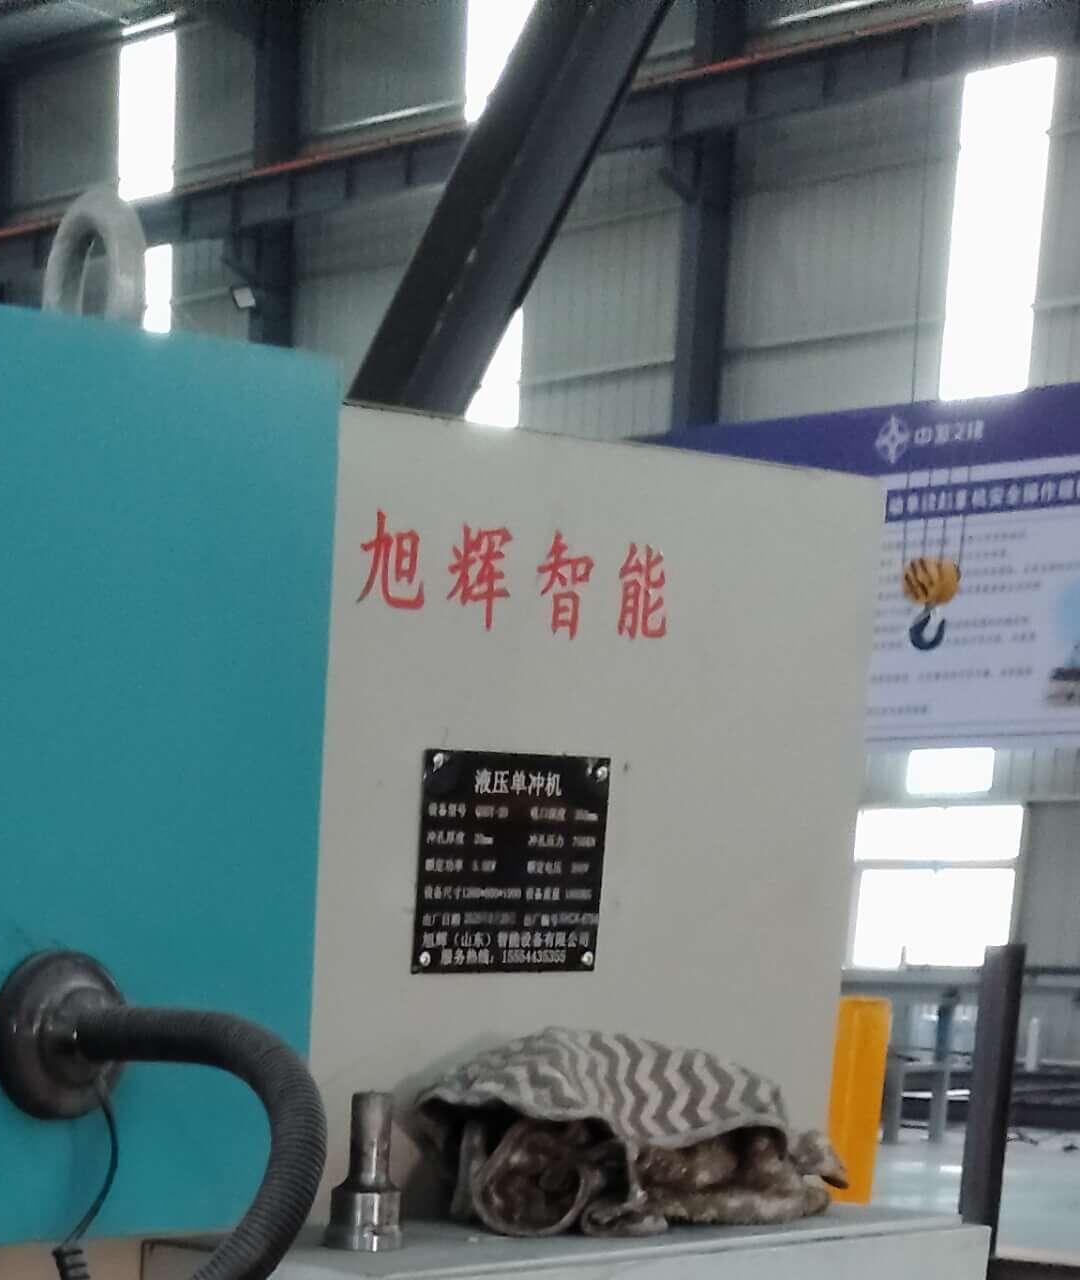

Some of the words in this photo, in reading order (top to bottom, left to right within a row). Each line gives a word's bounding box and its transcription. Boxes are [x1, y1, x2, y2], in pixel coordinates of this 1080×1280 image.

[358, 508, 667, 640] 旭辉智能
[474, 768, 563, 797] 液压单冲机
